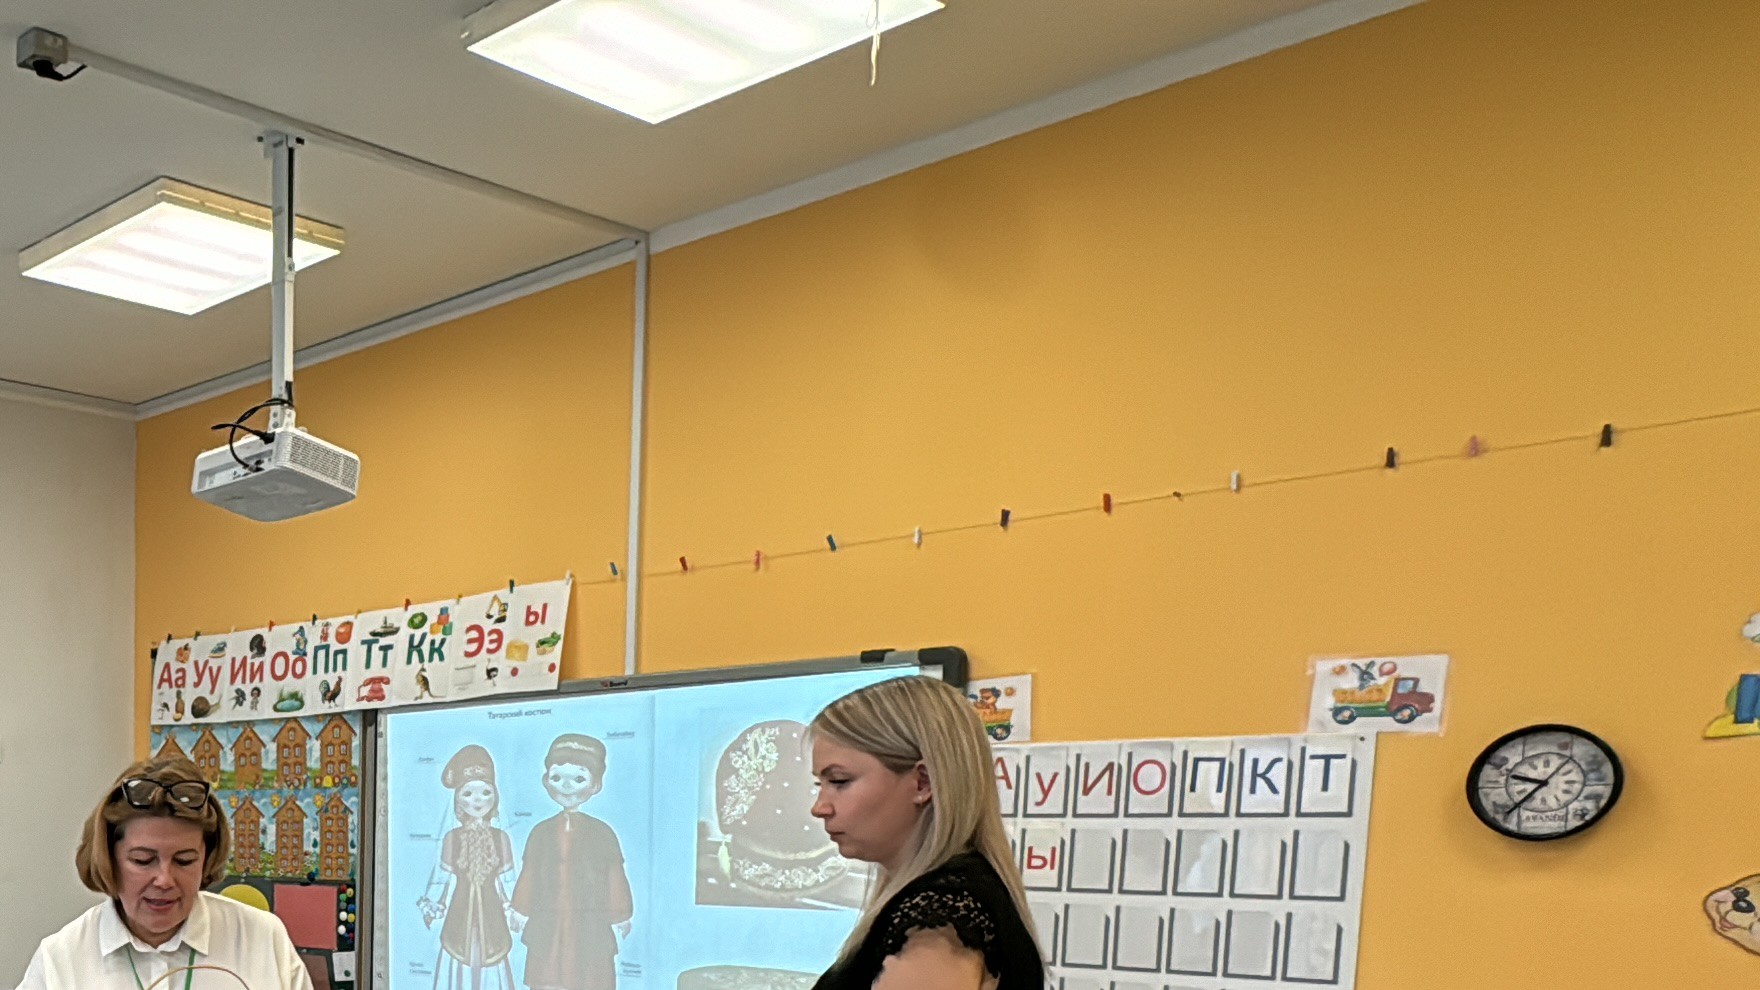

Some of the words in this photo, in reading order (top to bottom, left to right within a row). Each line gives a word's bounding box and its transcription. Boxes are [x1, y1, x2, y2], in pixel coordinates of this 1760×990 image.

[156, 661, 187, 690] Аа
[192, 658, 223, 695] Уу
[229, 655, 265, 686] Ии
[270, 650, 308, 682] Оо
[312, 643, 348, 676] Пп
[360, 638, 395, 670] Тт
[405, 631, 448, 666] Кк
[463, 623, 504, 659] Ээ
[1081, 761, 1115, 797] И
[1132, 759, 1168, 796] О
[1189, 756, 1227, 795] П
[1249, 756, 1284, 796] К
[1309, 753, 1347, 793] Т
